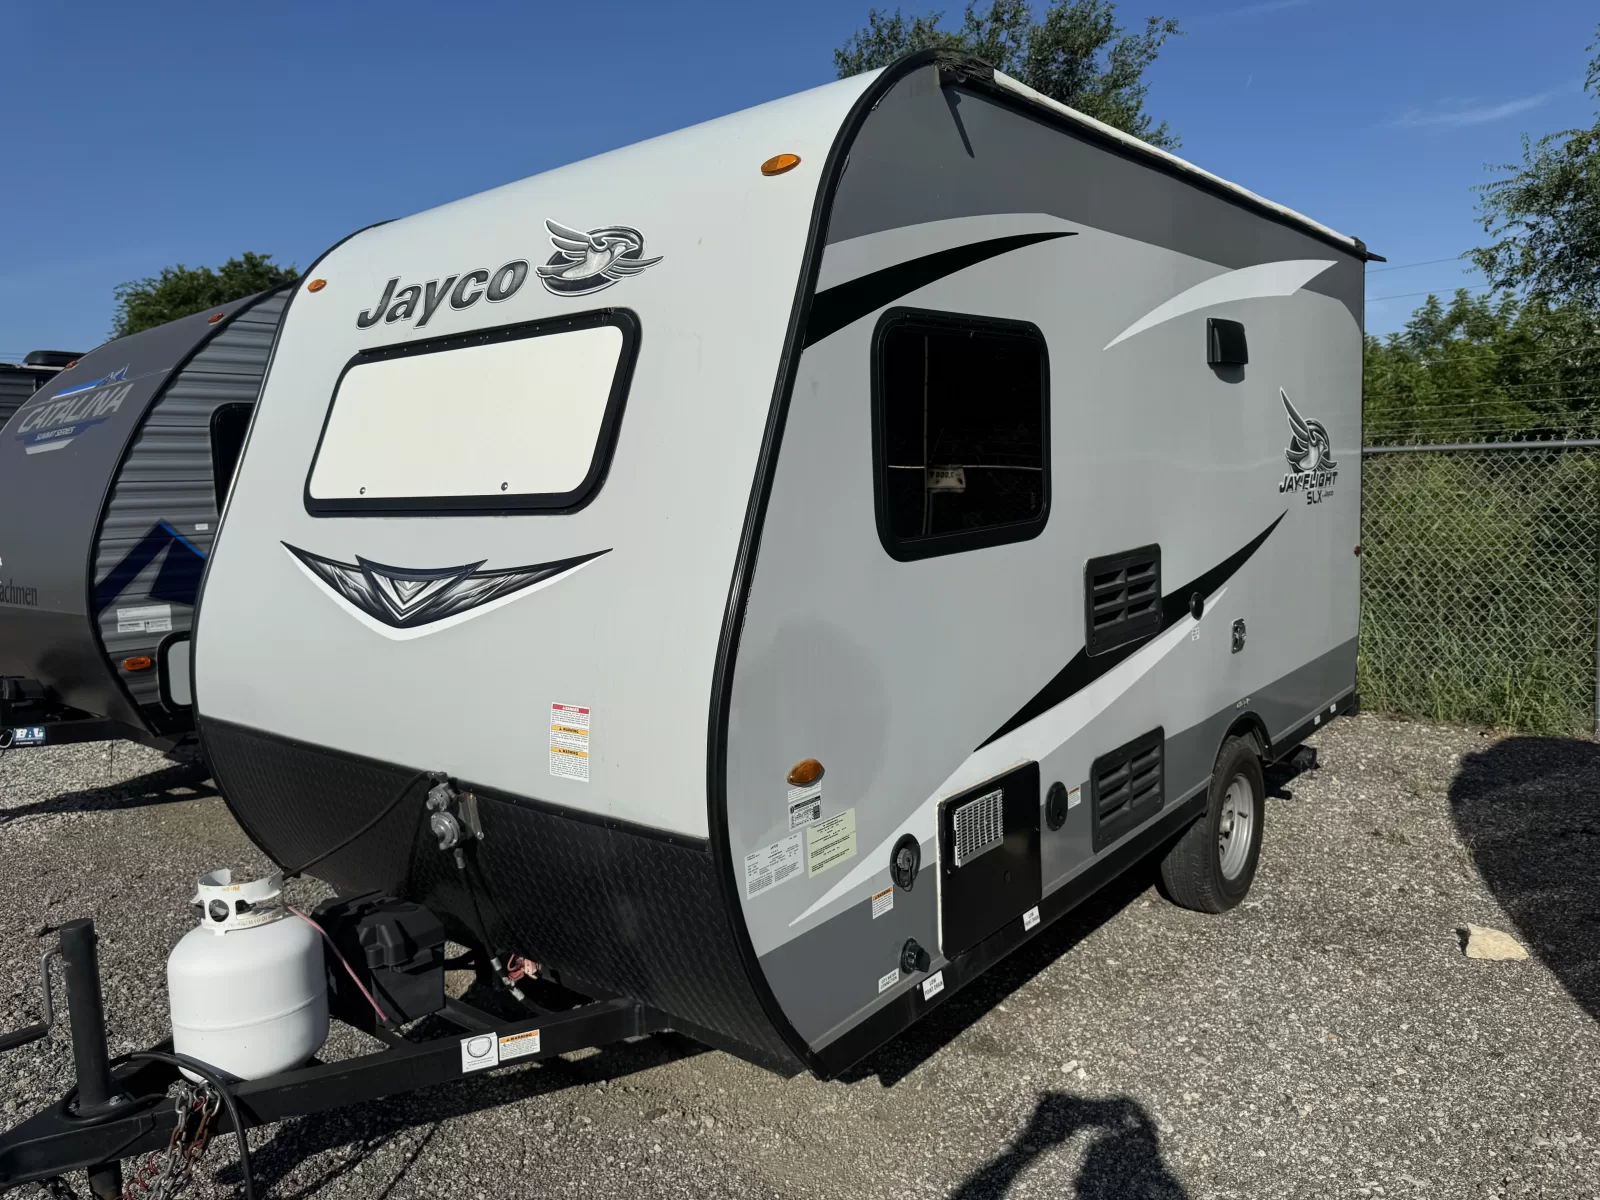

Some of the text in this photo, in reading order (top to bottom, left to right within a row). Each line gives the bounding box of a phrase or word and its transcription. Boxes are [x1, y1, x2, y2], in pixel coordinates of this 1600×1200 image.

[355, 258, 531, 331] Jayco
[17, 382, 134, 433] CATALINA
[55, 425, 76, 437] SERIES
[1307, 490, 1322, 505] SLX
[510, 1032, 533, 1041] WARNING
